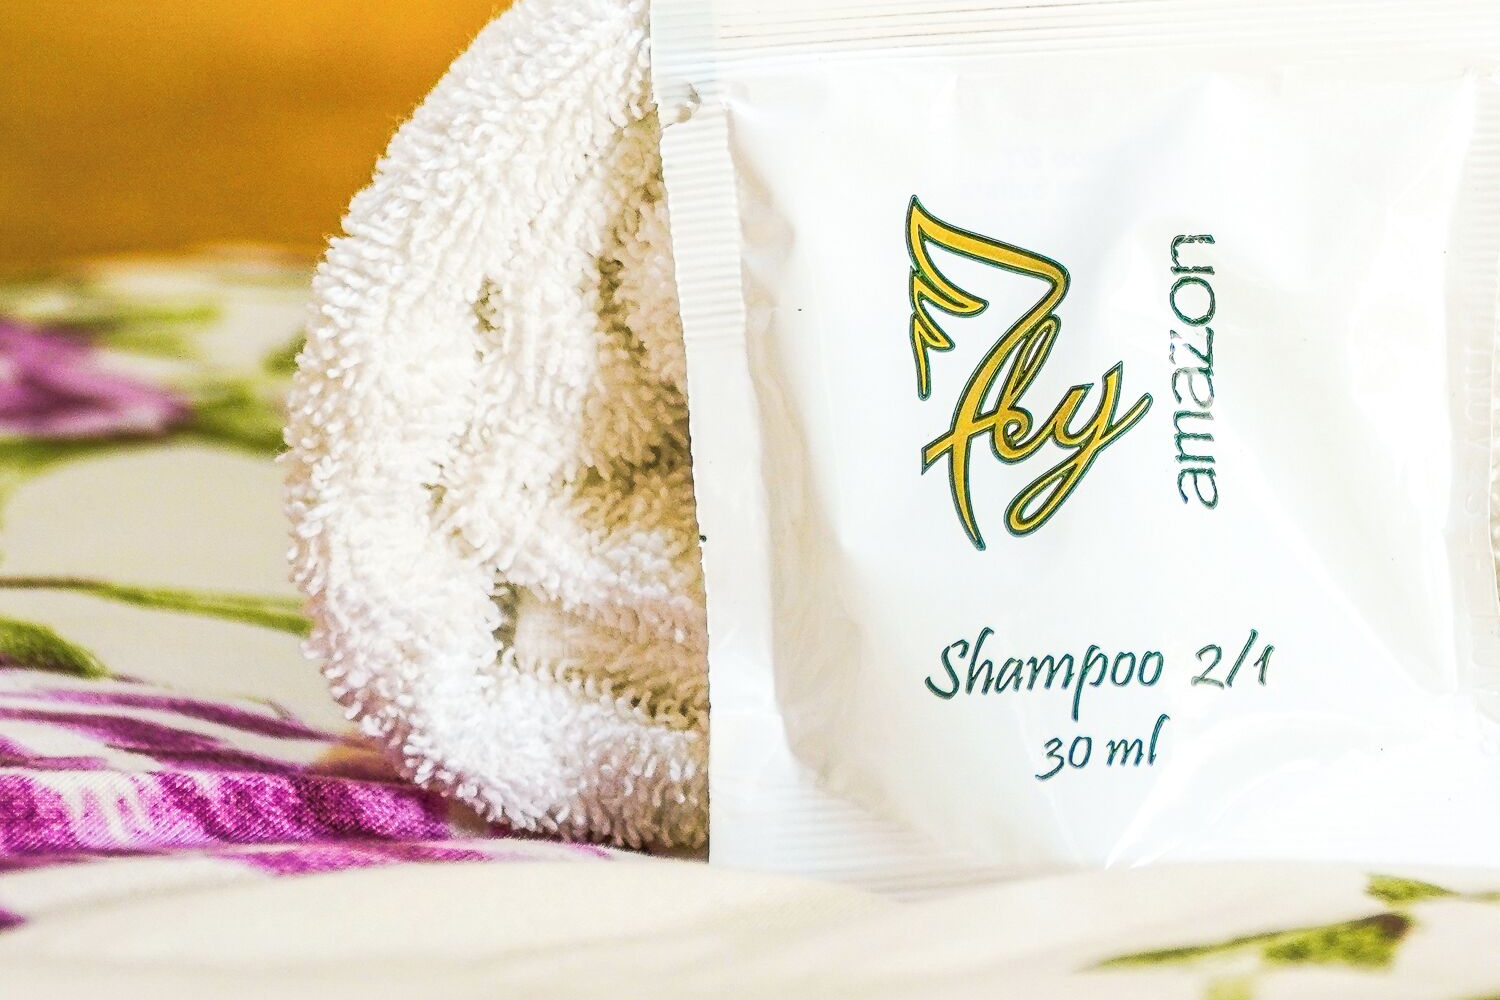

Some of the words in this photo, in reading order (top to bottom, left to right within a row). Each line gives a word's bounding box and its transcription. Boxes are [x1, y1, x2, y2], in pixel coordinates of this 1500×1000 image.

[1170, 234, 1219, 510] amazon
[924, 626, 1165, 720] Shampoo
[1192, 628, 1275, 689] 2/1
[1034, 735, 1093, 781] 30
[1105, 713, 1171, 767] ml
